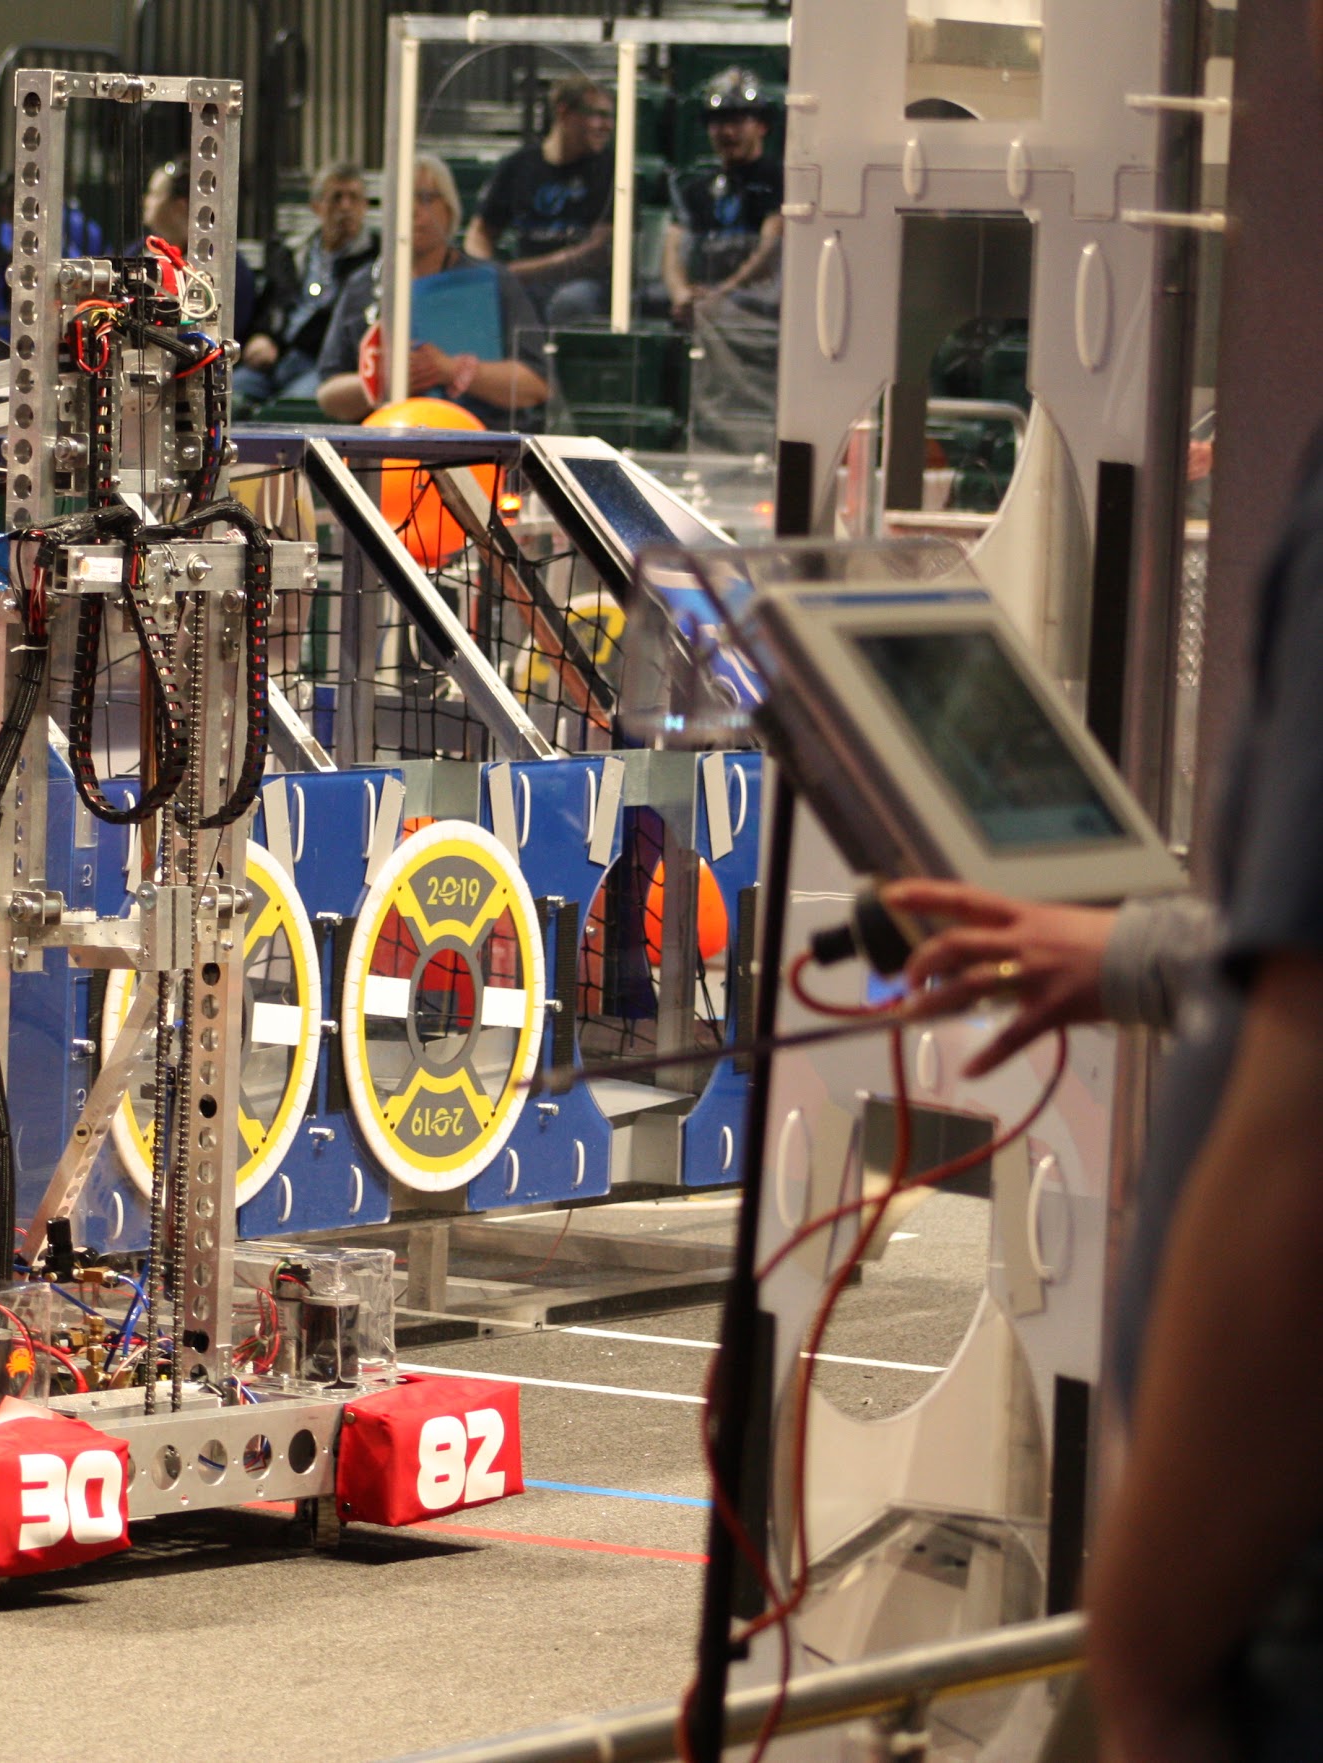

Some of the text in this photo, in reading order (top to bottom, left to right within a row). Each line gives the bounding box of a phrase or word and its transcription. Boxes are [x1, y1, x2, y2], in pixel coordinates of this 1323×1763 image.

[426, 875, 481, 907] 2019
[411, 1107, 465, 1137] 2019
[416, 1408, 506, 1510] 82
[18, 1449, 124, 1551] 30
